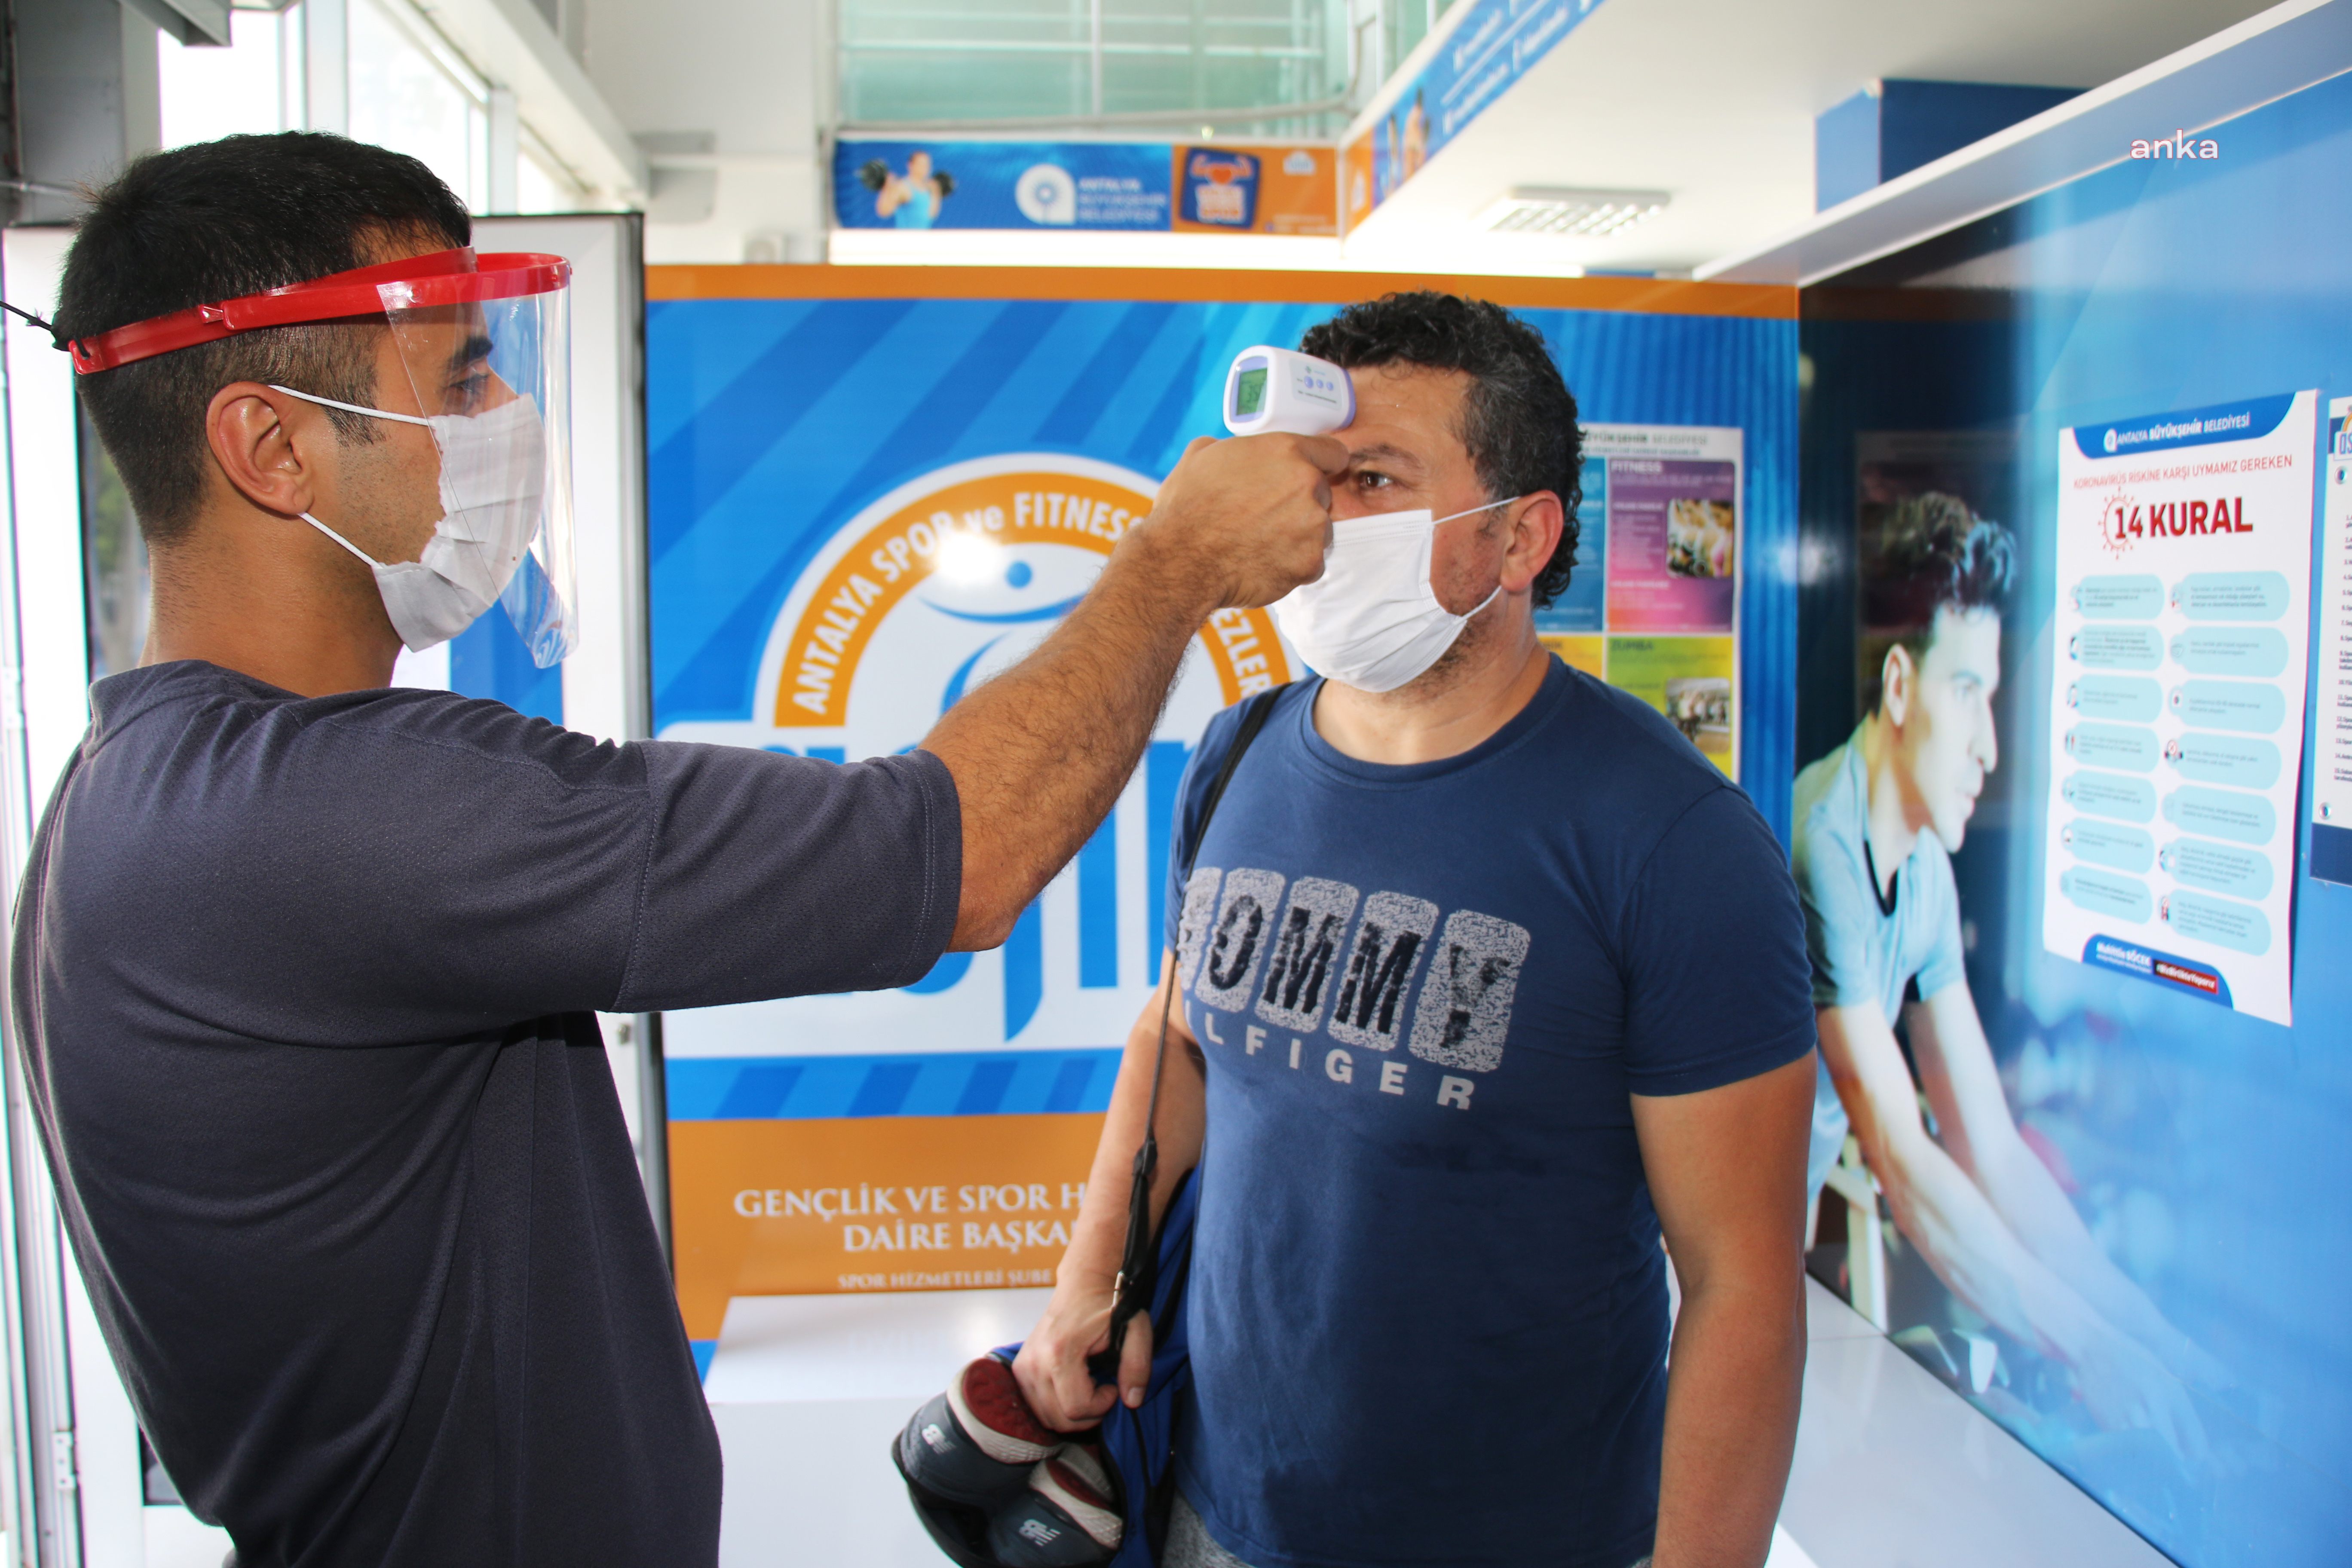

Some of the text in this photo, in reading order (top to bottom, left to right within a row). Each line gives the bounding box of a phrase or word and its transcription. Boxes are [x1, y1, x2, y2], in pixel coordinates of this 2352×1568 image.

[2149, 418, 2203, 441] BÜYÜKŞEHİR
[2203, 411, 2251, 433] BELEDİYESİ
[2128, 467, 2161, 483] RİSKİNE
[2163, 466, 2190, 481] KARŞI
[2192, 460, 2237, 477] UYMAMIZ
[2240, 454, 2292, 472] GEREKEN
[2114, 496, 2254, 539] 14 KURAL
[792, 573, 884, 716] ANTALYA
[870, 510, 954, 583] SPOR
[963, 505, 1005, 534] ve
[1209, 607, 1271, 699] EZLER
[1183, 881, 1517, 1057] OMMY
[734, 1182, 1087, 1223] GENÇLİK VE SPOR H
[844, 1219, 951, 1252] DAİRE
[838, 1268, 1052, 1289] SPOR HİZMETLERİ ŞUBE
